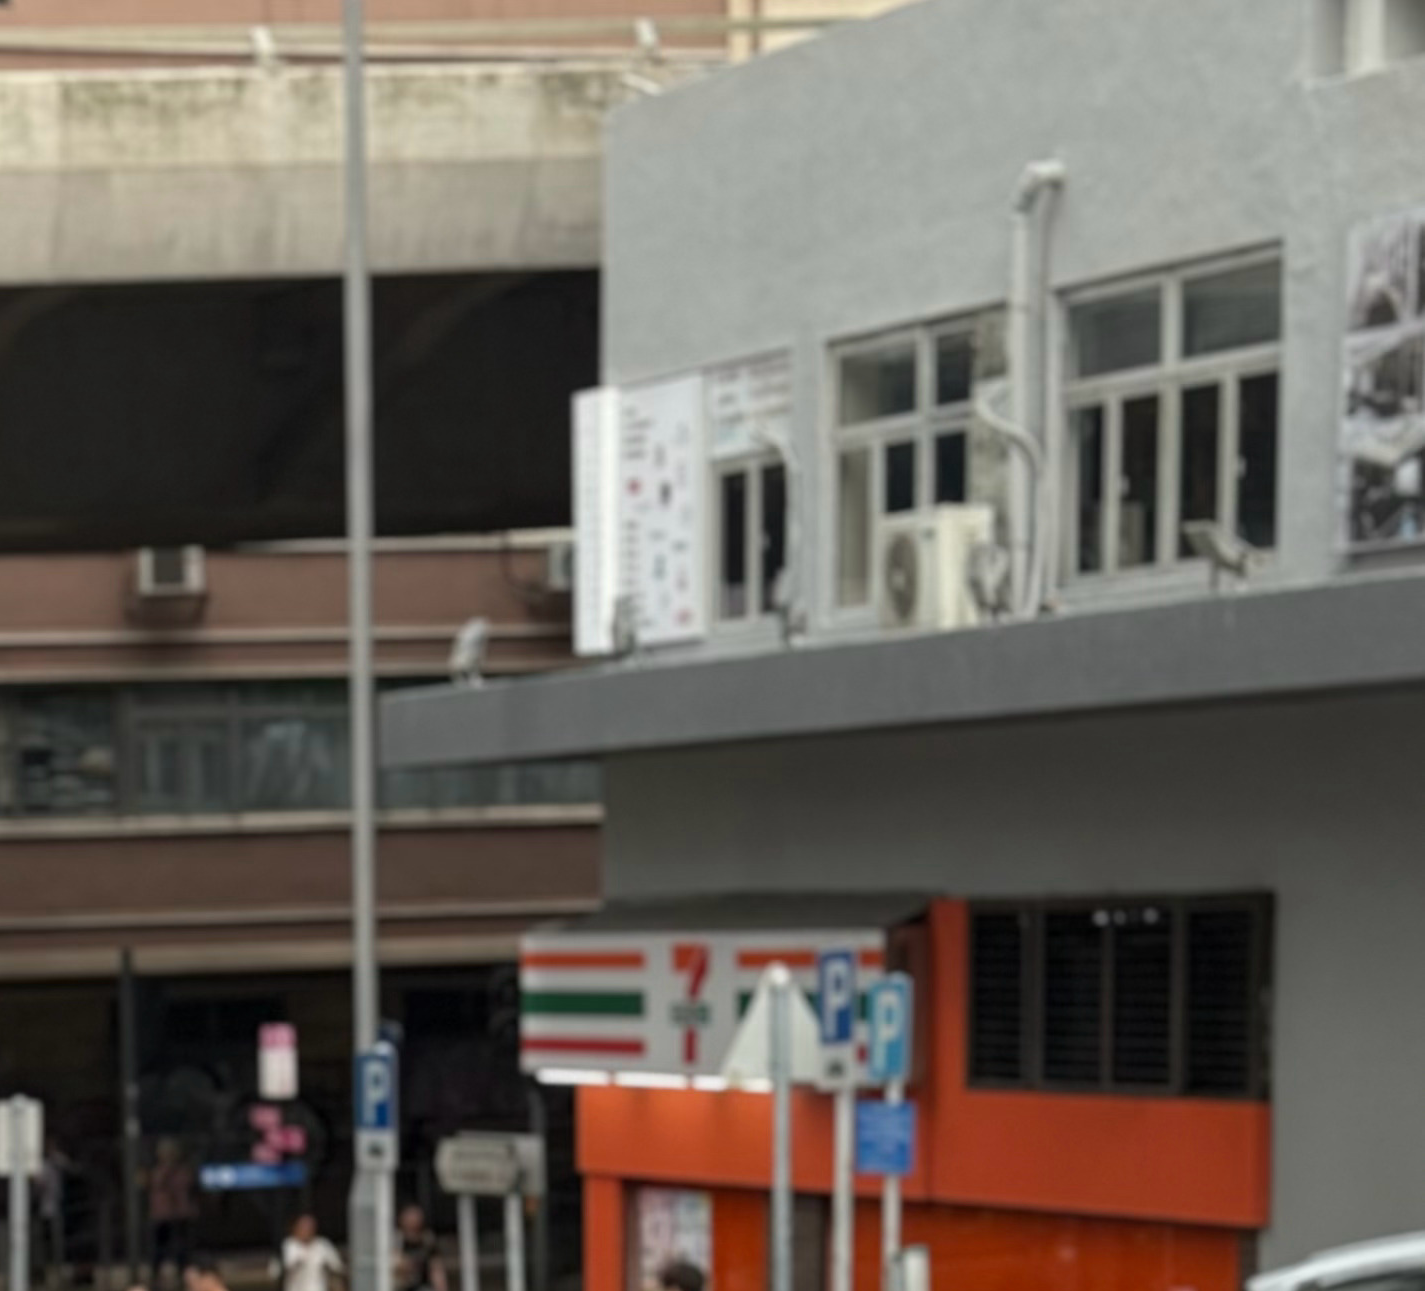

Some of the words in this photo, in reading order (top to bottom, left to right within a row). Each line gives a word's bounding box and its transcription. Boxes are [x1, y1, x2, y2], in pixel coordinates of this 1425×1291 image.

[825, 957, 850, 1043] P
[875, 989, 901, 1077] P
[362, 1060, 390, 1128] P
